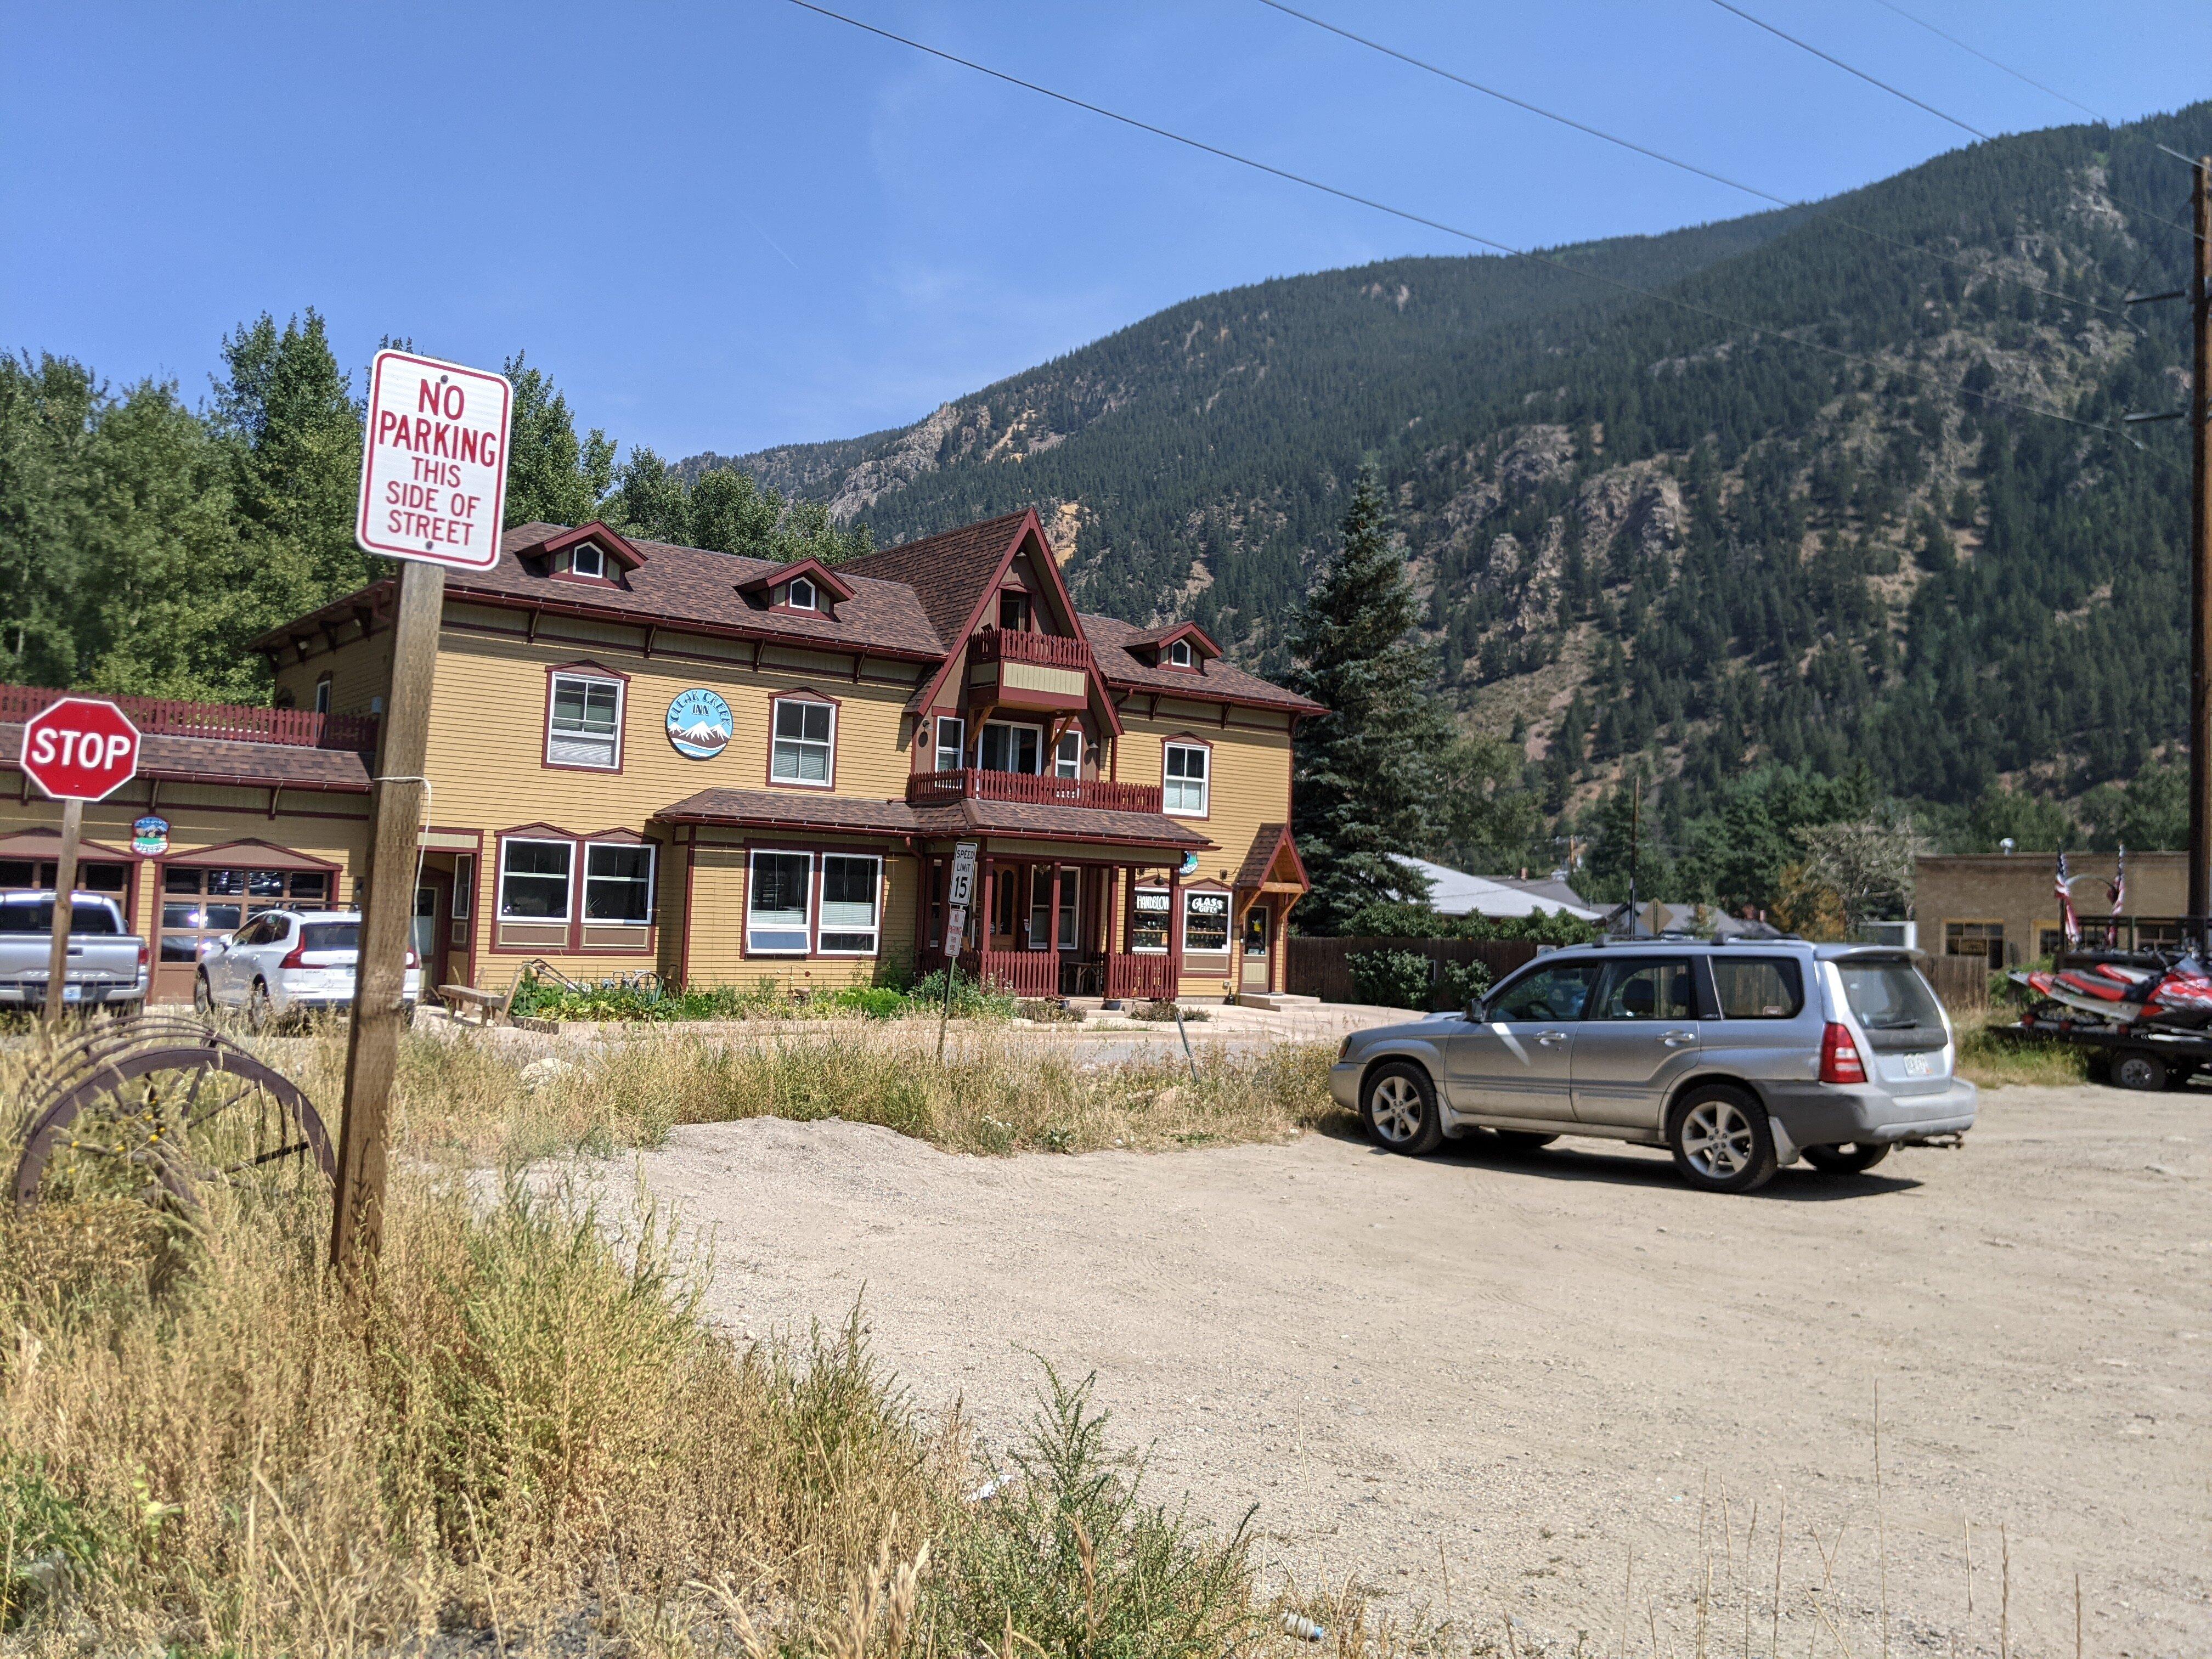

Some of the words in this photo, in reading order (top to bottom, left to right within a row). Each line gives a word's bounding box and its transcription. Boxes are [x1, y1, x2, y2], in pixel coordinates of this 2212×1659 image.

[419, 379, 465, 420] NO
[379, 410, 496, 467] PARKING
[411, 456, 461, 488] THIS
[386, 480, 439, 512] SIDE
[450, 493, 481, 518] OF
[387, 509, 474, 546] STREET
[669, 690, 699, 723] CLEAR
[702, 692, 731, 727] CREEK
[692, 704, 709, 716] INN
[31, 728, 131, 769] STOP
[956, 849, 974, 860] SPEED
[956, 862, 970, 872] LIMIT
[954, 876, 968, 899] 15
[1137, 895, 1170, 910] HANDBLOW
[1192, 897, 1223, 910] GLASS
[1198, 905, 1217, 914] GIFTS
